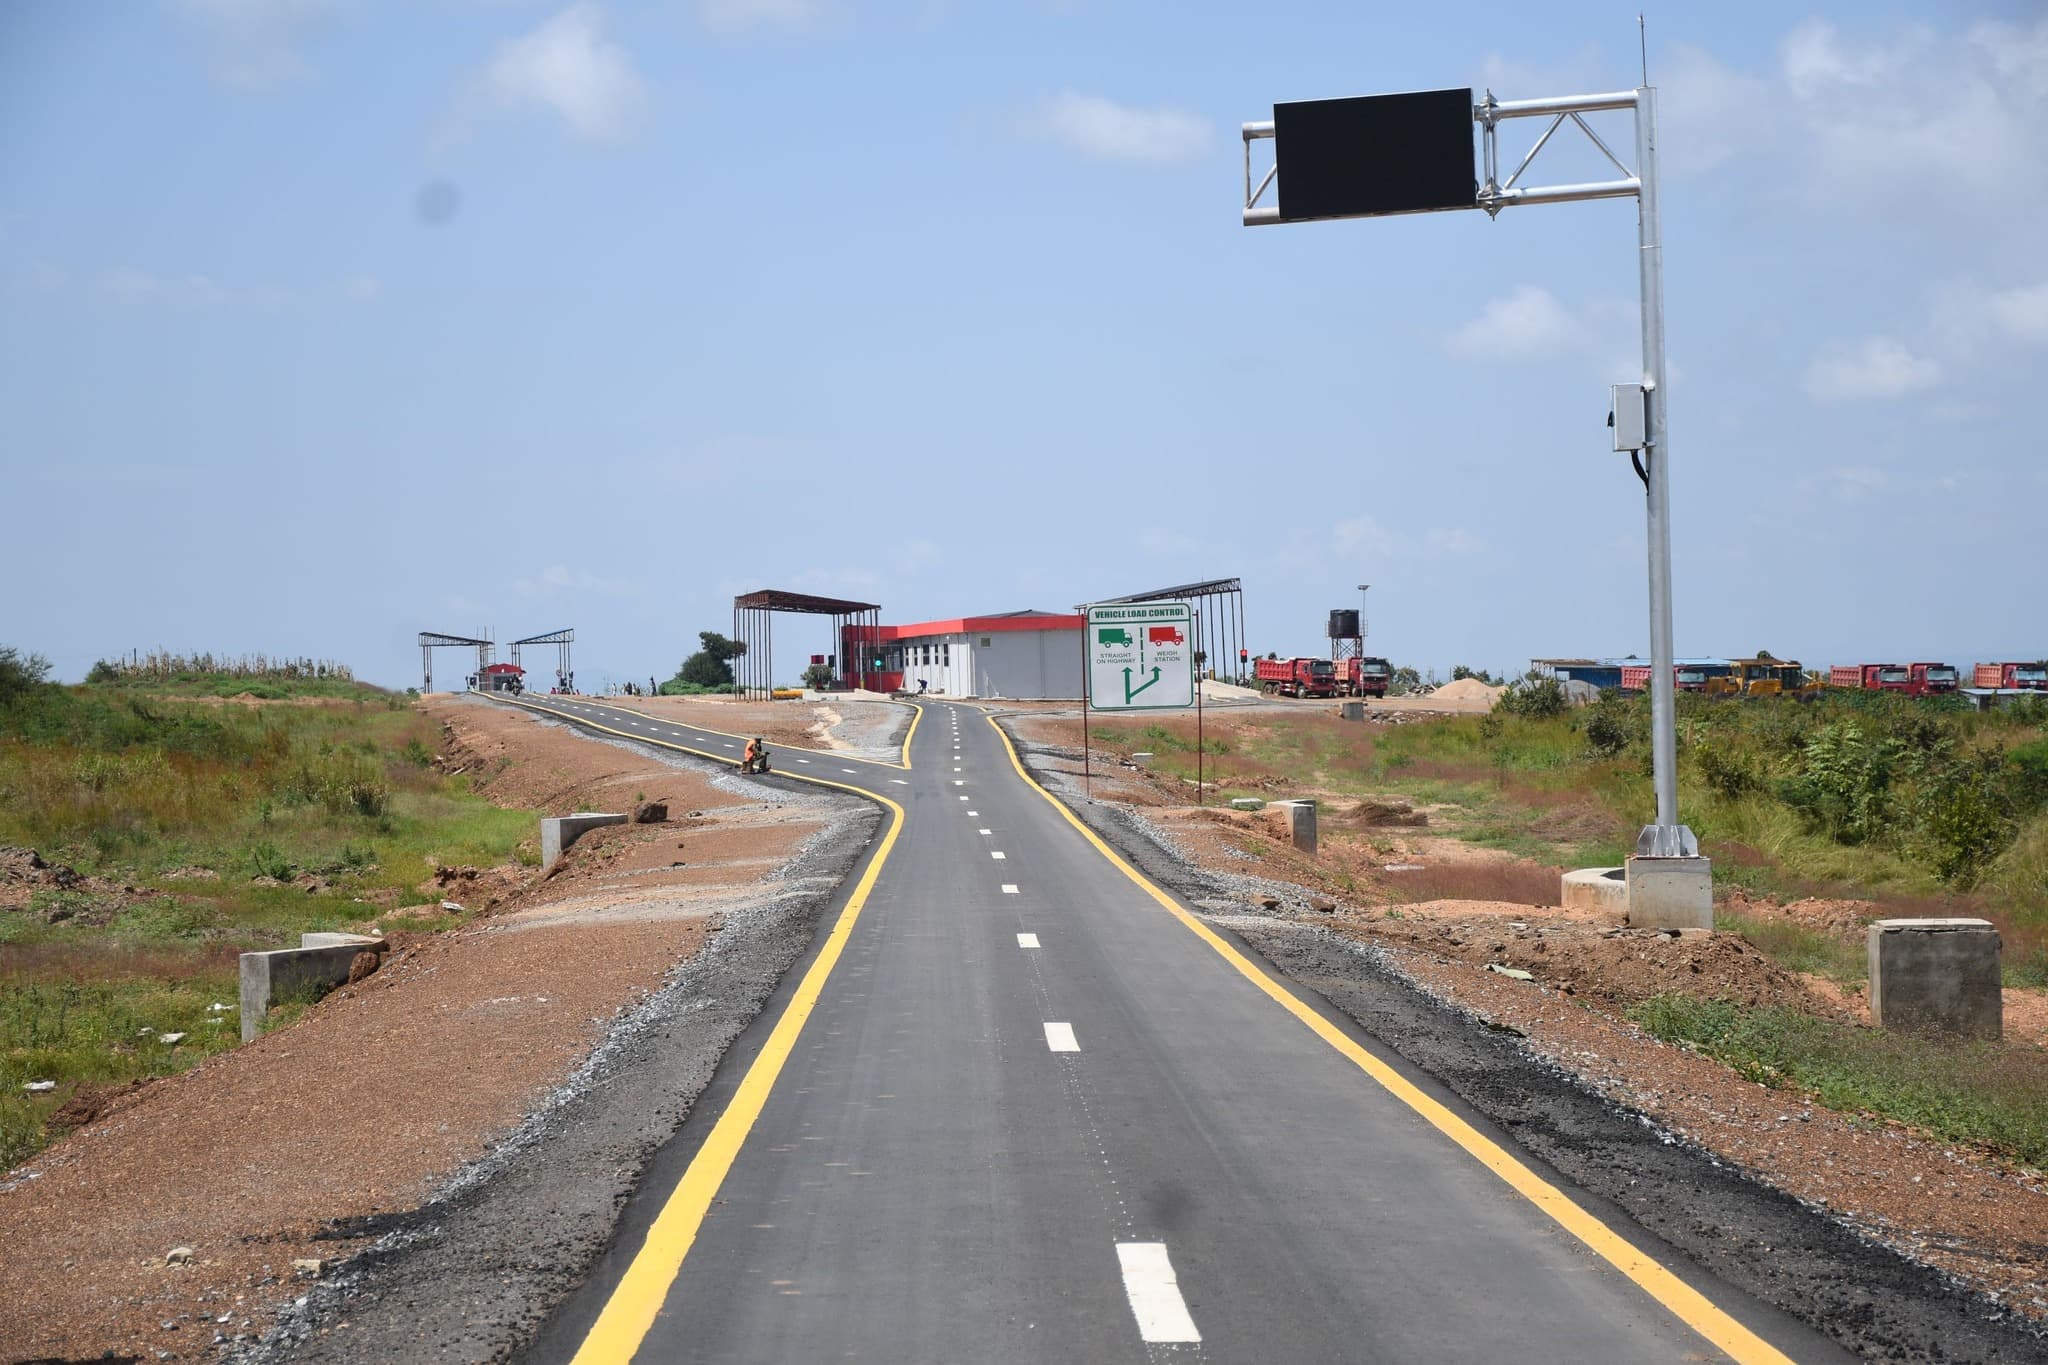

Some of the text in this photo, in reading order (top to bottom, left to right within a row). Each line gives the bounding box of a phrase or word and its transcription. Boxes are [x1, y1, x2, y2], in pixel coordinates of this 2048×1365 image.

[1095, 608, 1184, 619] VEHICLE LOAD CONTROL
